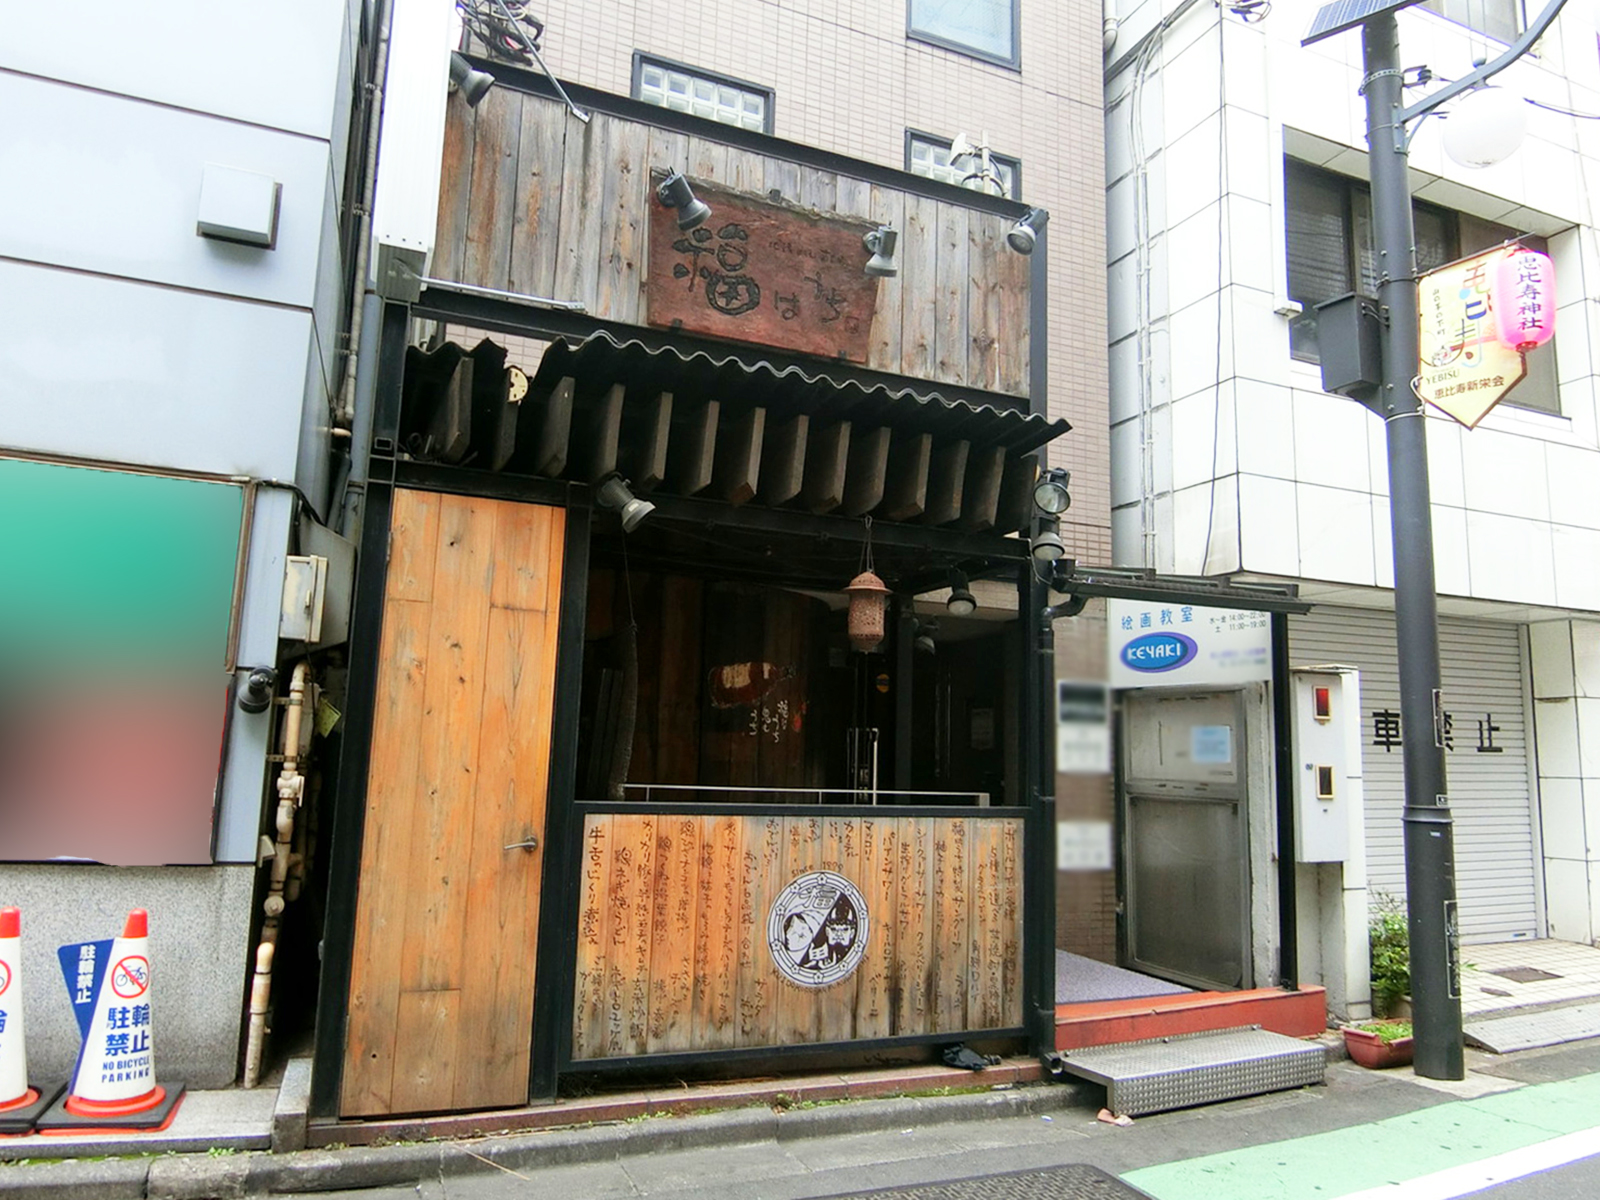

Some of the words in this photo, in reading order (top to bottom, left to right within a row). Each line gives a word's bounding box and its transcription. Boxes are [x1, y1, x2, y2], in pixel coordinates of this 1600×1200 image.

[1517, 255, 1543, 331] 恵比寿神社
[1426, 369, 1460, 385] YEBISU
[1434, 375, 1505, 399] 恵比寿新栄会
[1121, 606, 1193, 630] 絵画教室
[1126, 642, 1181, 661] KEYAKI
[881, 831, 896, 902] パインサワー
[75, 943, 97, 1005] 駐輪禁止
[106, 1003, 150, 1030] 駐輪
[105, 1030, 150, 1057] 禁止
[101, 1067, 150, 1084] PARKING
[102, 1061, 115, 1071] NO
